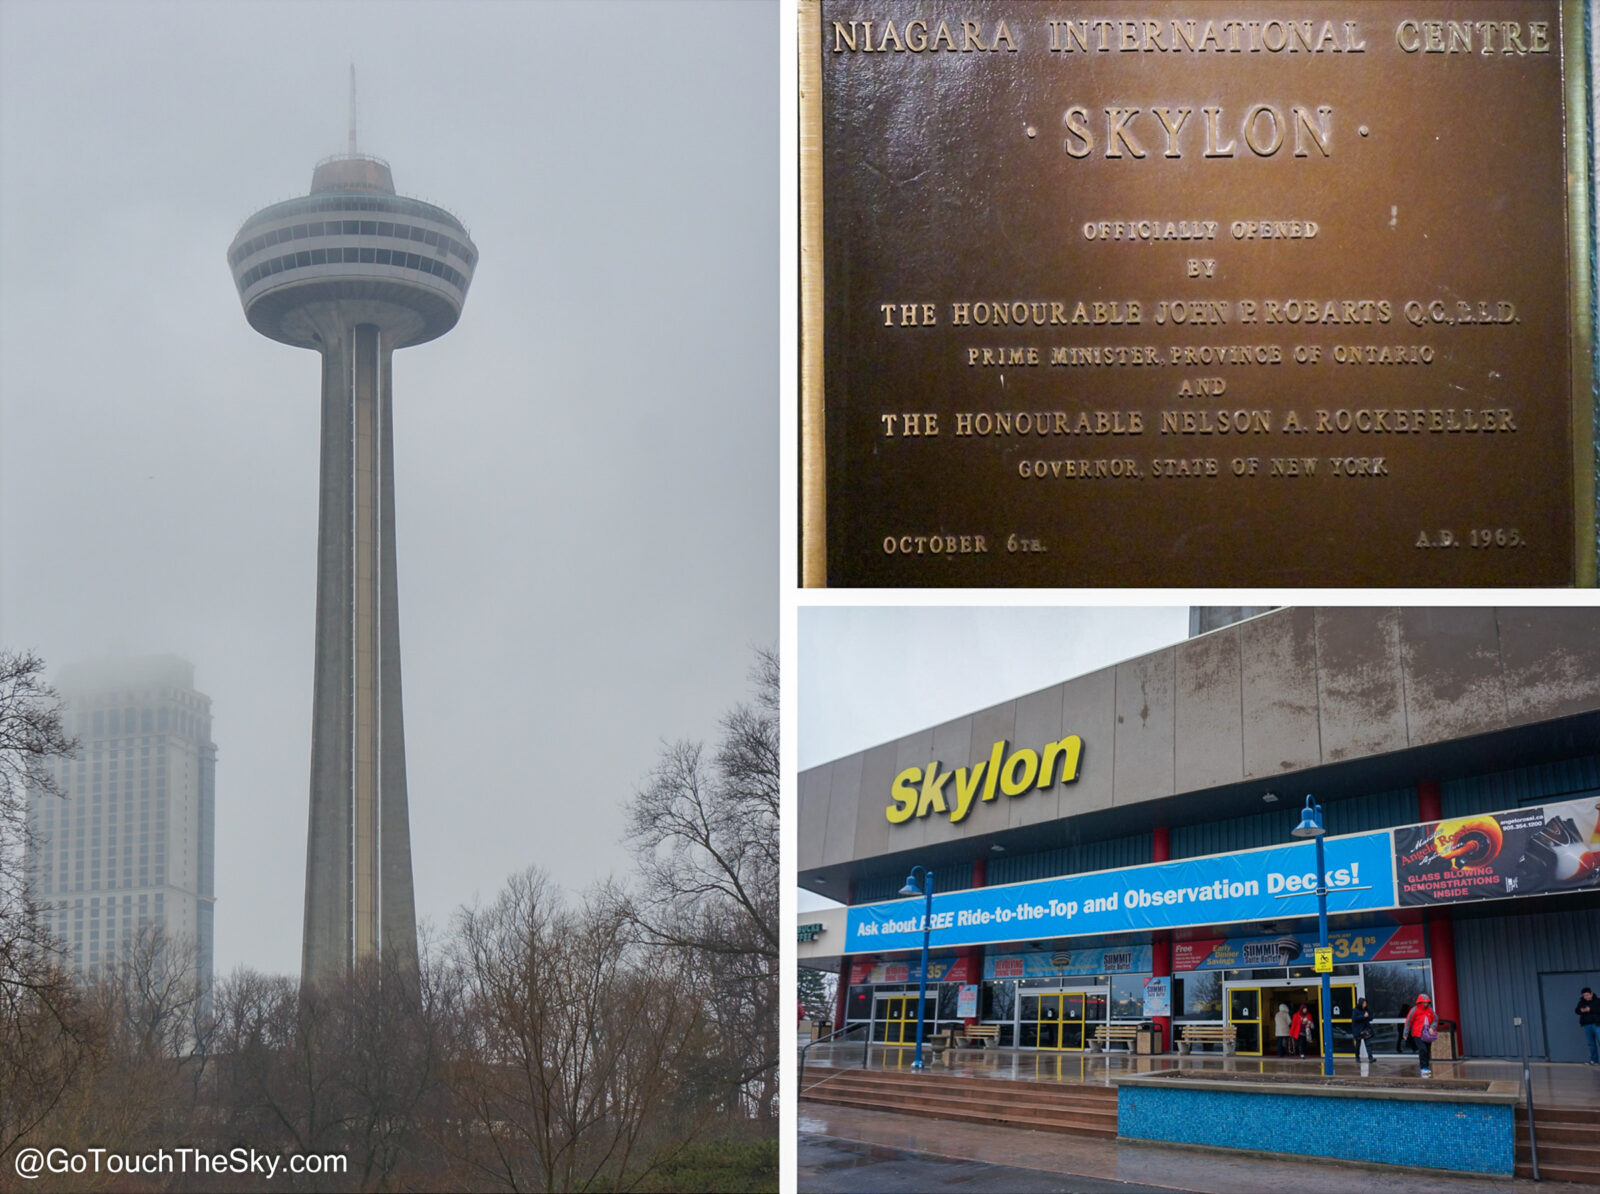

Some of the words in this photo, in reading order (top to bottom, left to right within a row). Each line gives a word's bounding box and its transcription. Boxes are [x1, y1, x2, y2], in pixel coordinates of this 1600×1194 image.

[833, 20, 1017, 52] NIAGARA
[1050, 20, 1366, 53] INTERNATIONAL
[1396, 20, 1550, 54] CENTRE
[1064, 105, 1332, 159] SKYLON
[1083, 221, 1218, 241] OFFICIALLY
[1231, 220, 1319, 239] OPENED
[1187, 259, 1215, 278] BY
[880, 303, 936, 326] THE
[953, 302, 1142, 325] HONOURABLE
[1155, 301, 1227, 324] JOHN
[1241, 301, 1257, 324] P.
[1265, 300, 1391, 323] ROBARTS
[968, 348, 1039, 365] PRIME
[1051, 347, 1166, 367] MINISTER,
[1170, 346, 1281, 364] PROVINCE
[1294, 346, 1322, 363] OF
[1334, 346, 1434, 364] ONTARIO
[1178, 378, 1226, 397] AND
[881, 413, 939, 436] THE
[955, 412, 1144, 436] HONOURABLE
[1161, 410, 1271, 434] NELSON
[1283, 410, 1308, 434] A.
[1316, 409, 1517, 434] ROCKEFELLER
[1018, 459, 1144, 480] GOVERNOR,
[1152, 458, 1219, 477] STATE
[1231, 458, 1259, 477] OF
[1271, 458, 1318, 477] NEW
[1330, 457, 1388, 477] YORK
[883, 535, 988, 554] OCTOBER
[1415, 530, 1459, 548] A.D.
[885, 734, 1085, 825] Skylon
[1401, 843, 1437, 867] Angelo
[1403, 875, 1500, 892] DEMONSTRATIONS
[1408, 872, 1440, 883] GLASS
[1443, 867, 1493, 878] BLOWING
[857, 921, 879, 936] Ask
[881, 917, 917, 934] about
[919, 911, 955, 931] FREE
[957, 899, 1078, 926] Ride-to-the-Top
[1083, 892, 1119, 913] and
[1124, 879, 1259, 908] Observation
[1267, 862, 1359, 894] Decks!
[1433, 888, 1469, 898] INSIDE
[1104, 952, 1132, 965] SUMMIT
[1175, 945, 1192, 953] Free
[1213, 944, 1231, 953] Early
[1243, 943, 1280, 958] SUMMIT
[1207, 957, 1235, 966] Savings
